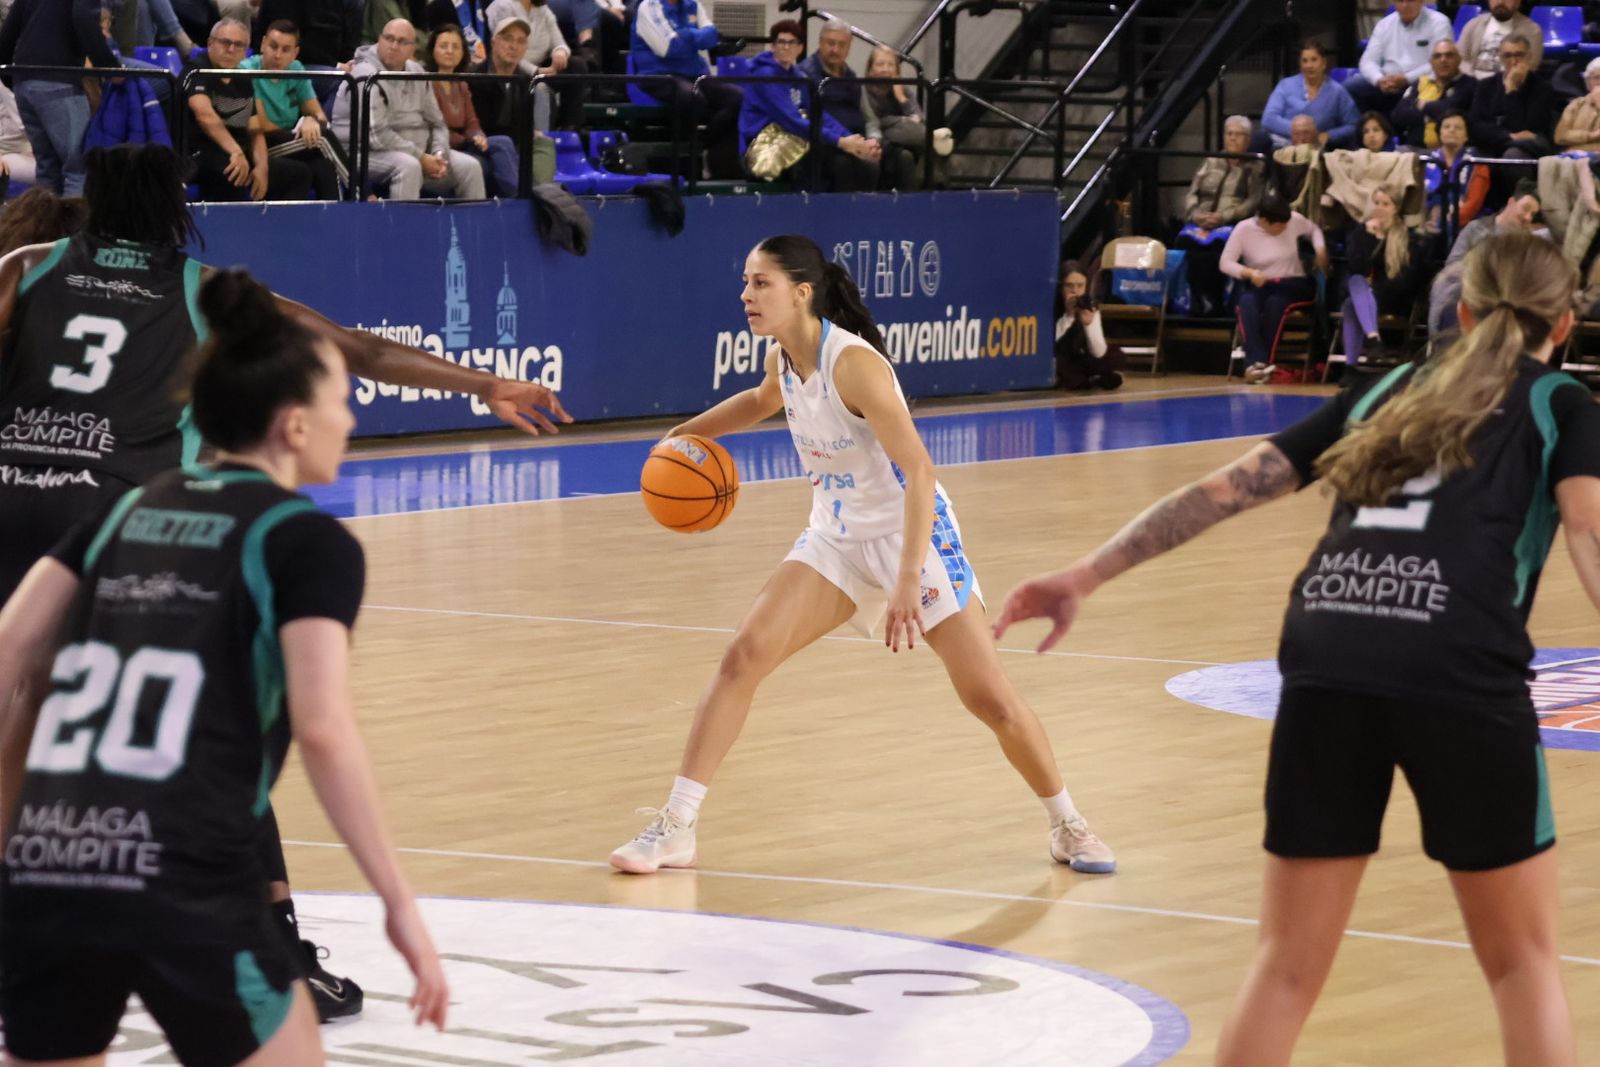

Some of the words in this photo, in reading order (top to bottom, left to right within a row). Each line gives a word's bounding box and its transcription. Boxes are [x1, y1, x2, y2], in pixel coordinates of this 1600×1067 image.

[50, 313, 128, 394] 3
[357, 318, 423, 348] rismo
[1317, 548, 1442, 581] MÁLAGA
[1302, 573, 1450, 613] COMPITE
[26, 640, 206, 781] 20
[18, 798, 153, 842] MÁLAGA
[5, 834, 165, 876] COMPITE
